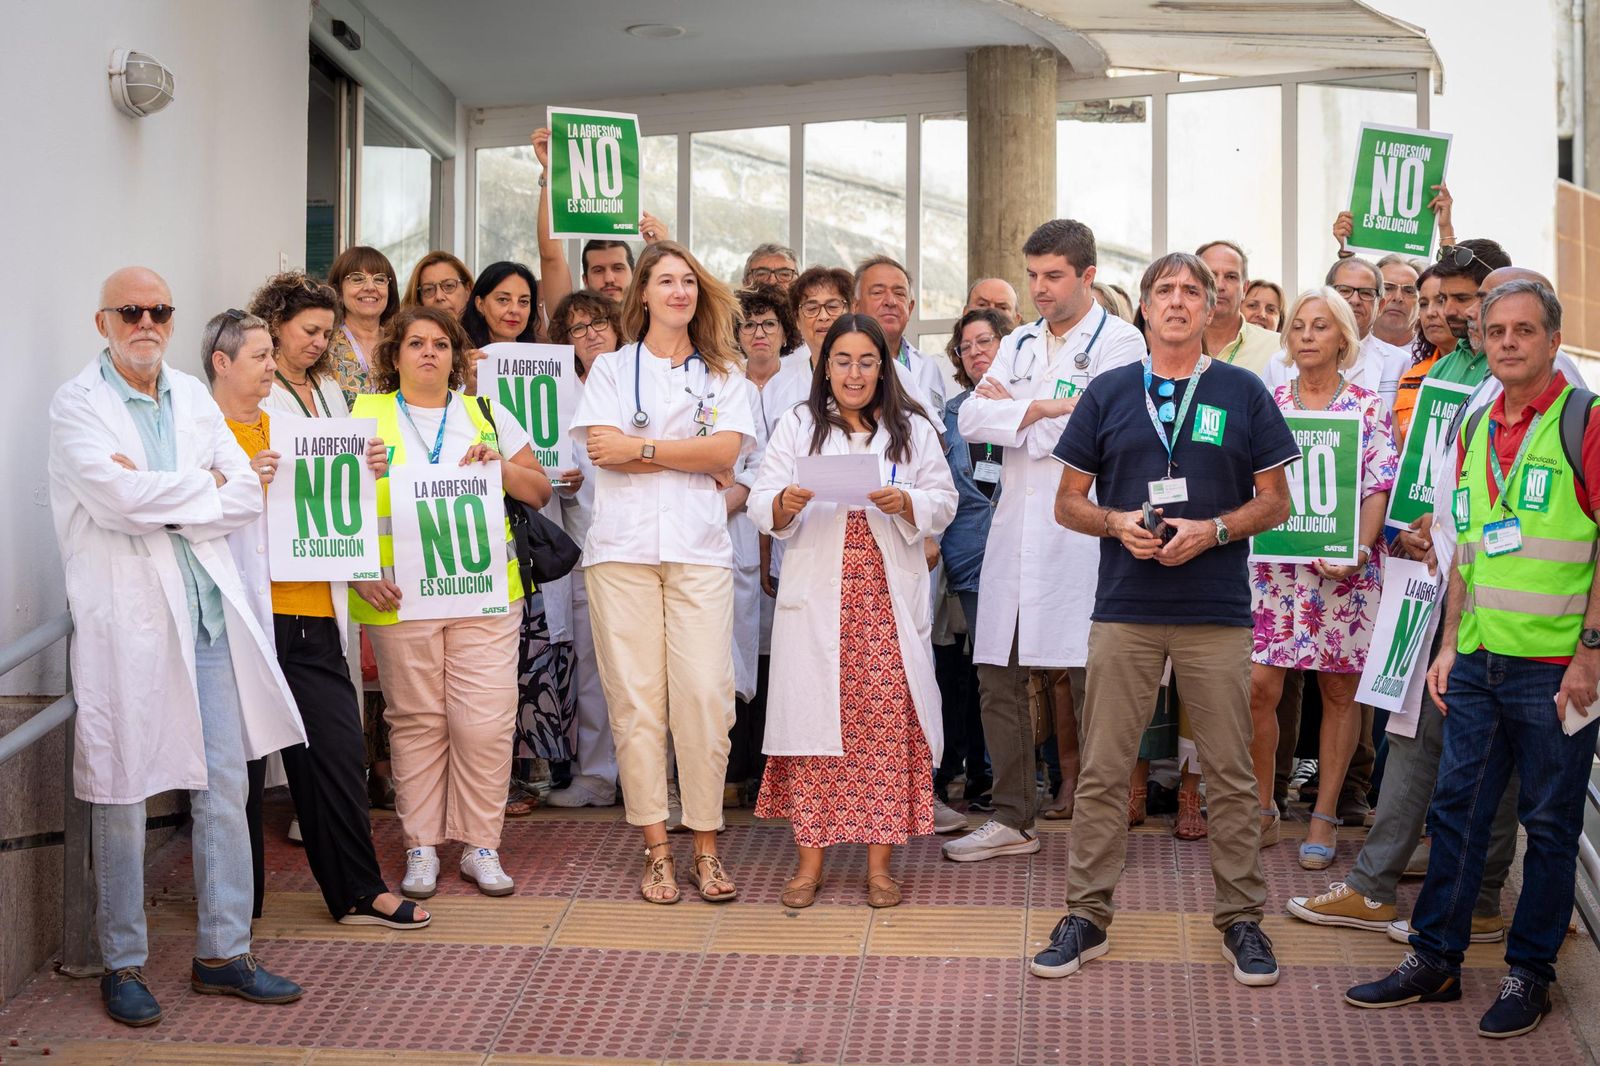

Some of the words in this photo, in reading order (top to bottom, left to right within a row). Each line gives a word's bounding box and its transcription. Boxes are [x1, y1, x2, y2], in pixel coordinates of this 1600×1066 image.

[567, 123, 578, 138] LA
[580, 124, 622, 139] AGRESIÓN
[1375, 140, 1386, 156] LA
[1387, 142, 1431, 161] AGRESIÓN
[568, 137, 623, 200] NO
[1369, 156, 1425, 218] NO
[567, 199, 578, 213] ES
[580, 198, 623, 213] SOLUCIÓN
[1363, 213, 1375, 228] ES
[1375, 215, 1419, 235] SOLUCIÓN
[497, 359, 509, 375] LA
[512, 358, 561, 377] AGRESIÓN
[497, 374, 559, 449] NO
[1430, 399, 1442, 417] LA
[1201, 409, 1220, 432] NO
[295, 437, 309, 456] LA
[311, 434, 366, 456] AGRESIÓN
[1527, 453, 1558, 466] Sindicato
[414, 481, 429, 499] LA
[431, 476, 488, 498] AGRESIÓN
[1284, 444, 1338, 516] NO
[1526, 473, 1547, 498] NO
[294, 453, 363, 540] NO
[1408, 482, 1421, 501] ES
[1286, 514, 1337, 533] SOLUCIÓN
[292, 539, 306, 558] ES
[309, 536, 364, 558] SOLUCIÓN
[415, 494, 492, 579] NO
[420, 578, 434, 596] ES
[437, 573, 493, 596] SOLUCIÓN
[1404, 577, 1417, 598] LA
[481, 606, 508, 614] SATSE
[1382, 599, 1434, 678] NO
